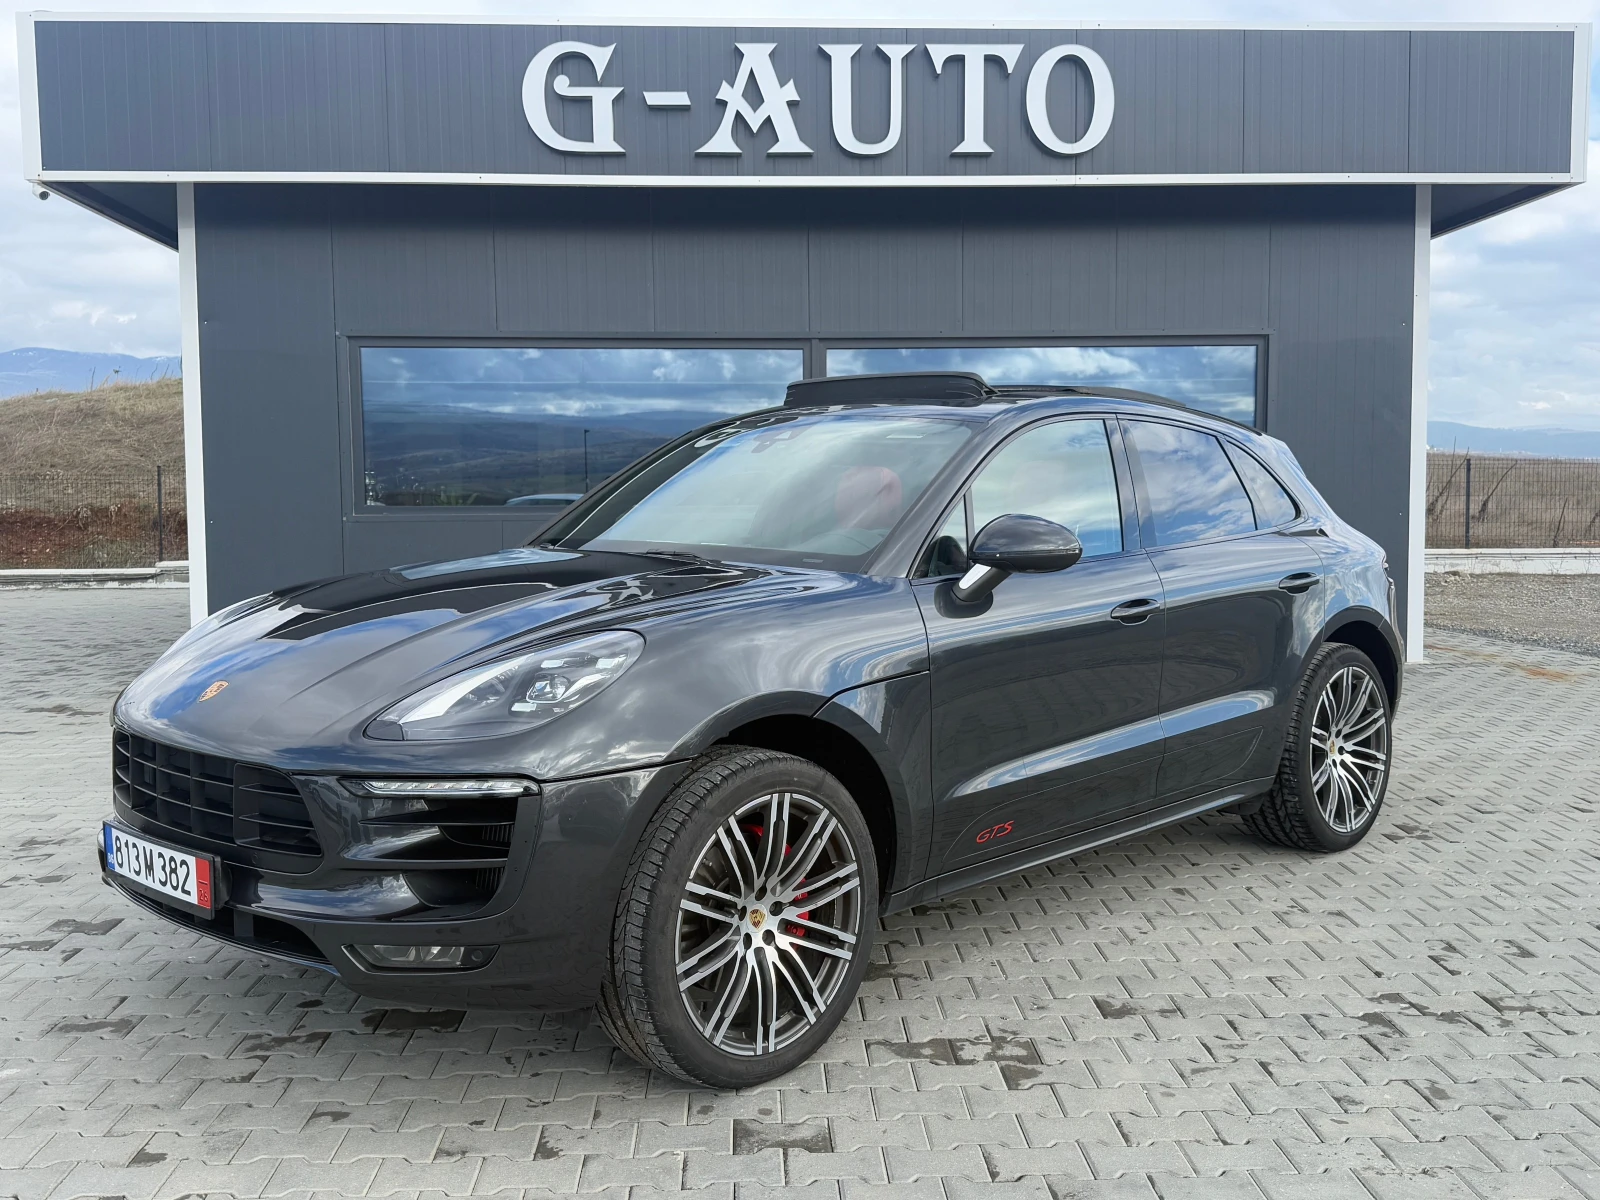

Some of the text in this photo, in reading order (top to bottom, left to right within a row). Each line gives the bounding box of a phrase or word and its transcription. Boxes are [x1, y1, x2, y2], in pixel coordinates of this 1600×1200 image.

[521, 40, 1116, 156] G-AUTO
[976, 820, 1015, 844] GTS
[114, 835, 192, 896] 813M382
